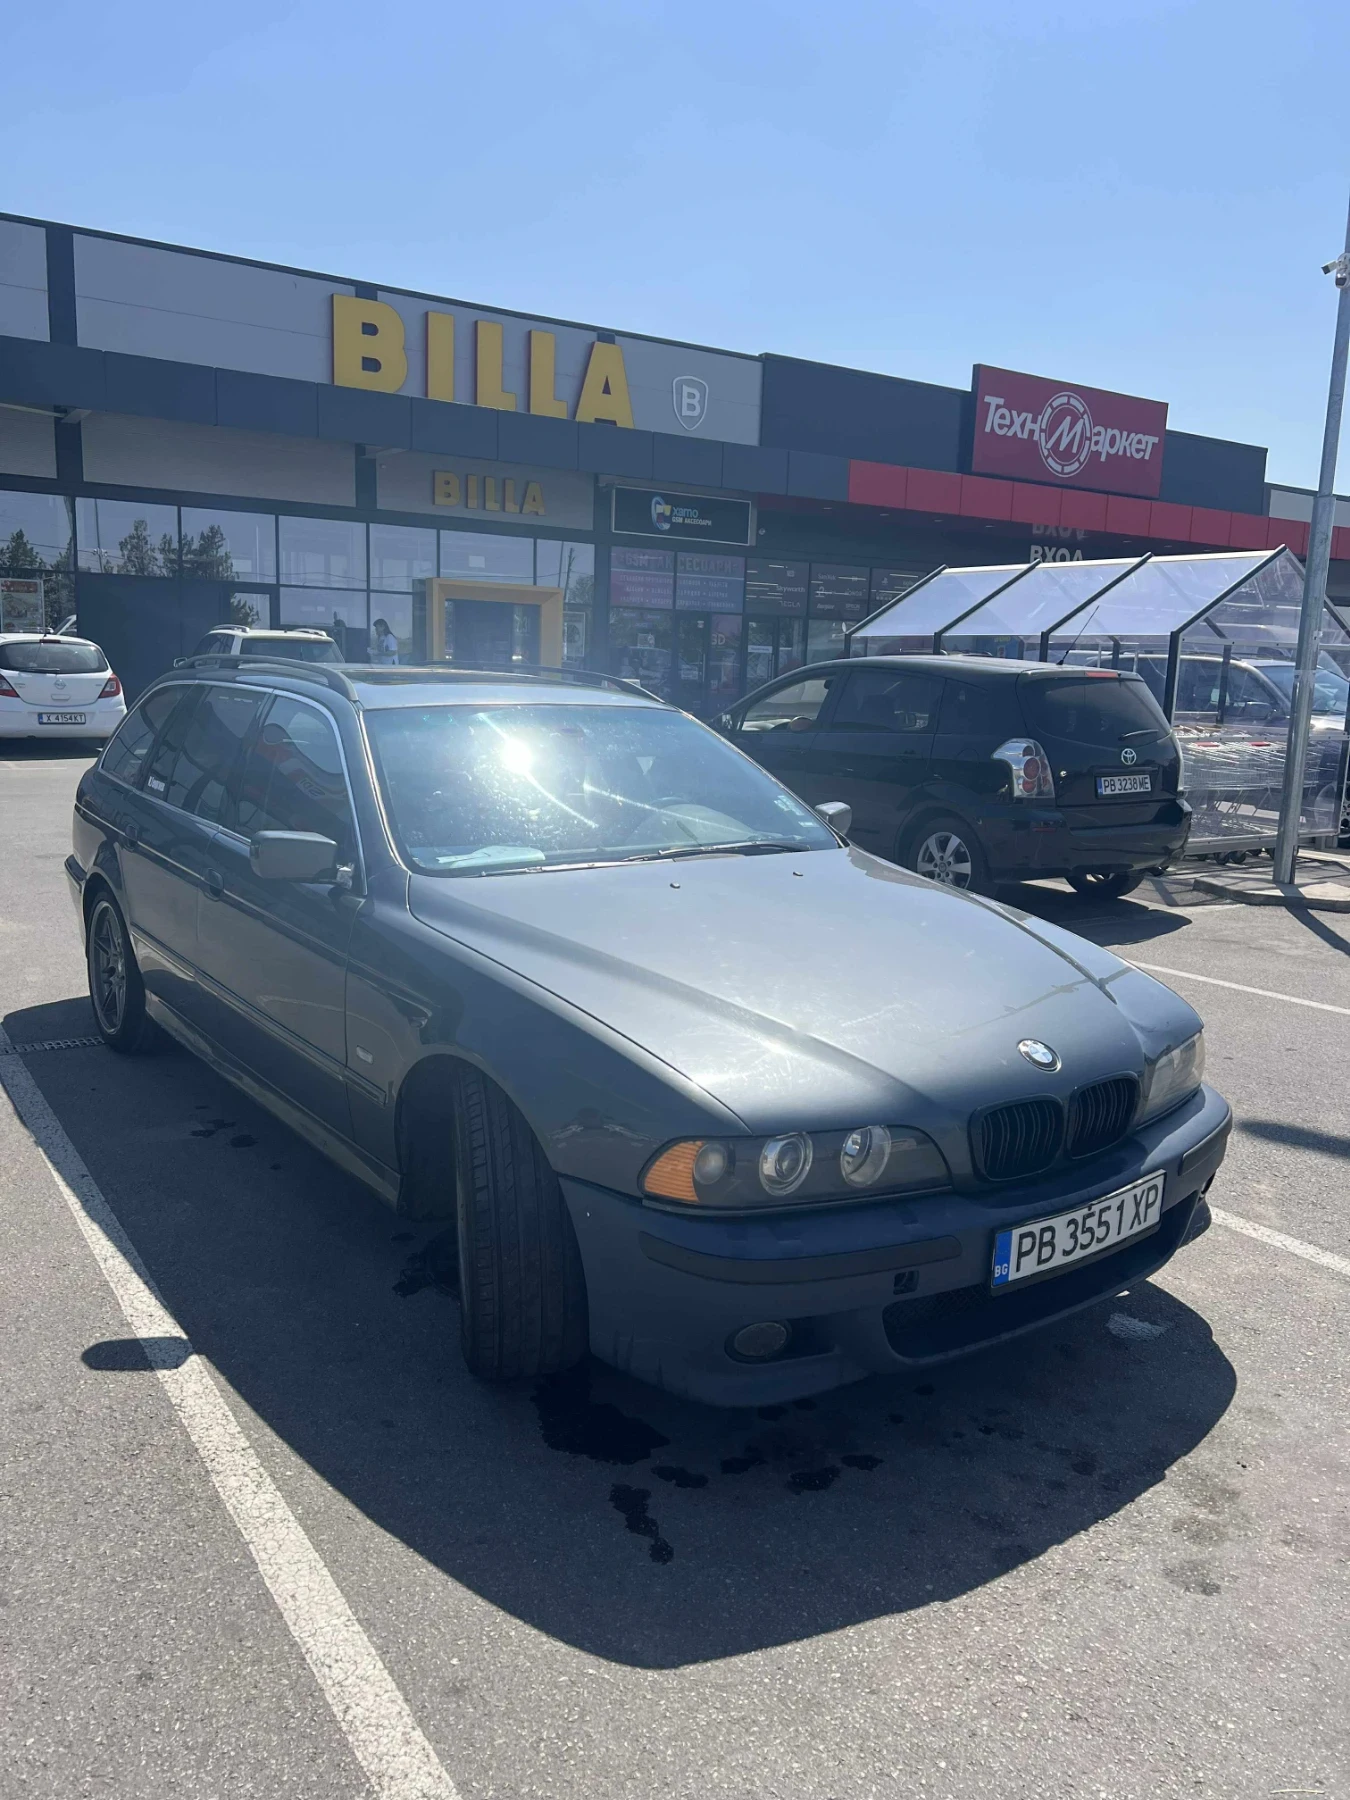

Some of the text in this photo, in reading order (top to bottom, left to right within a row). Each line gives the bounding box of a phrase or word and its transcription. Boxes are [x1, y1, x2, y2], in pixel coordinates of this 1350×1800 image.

[332, 293, 635, 428] BILLA
[681, 383, 702, 417] B
[432, 470, 546, 516] BILLA
[671, 516, 684, 524] GSM
[711, 633, 726, 645] 3D
[47, 713, 84, 722] X 4154 KT
[1103, 776, 1150, 793] PB 3238 ME
[1015, 1183, 1160, 1273] PB 3551 XP
[994, 1263, 1009, 1278] BG
